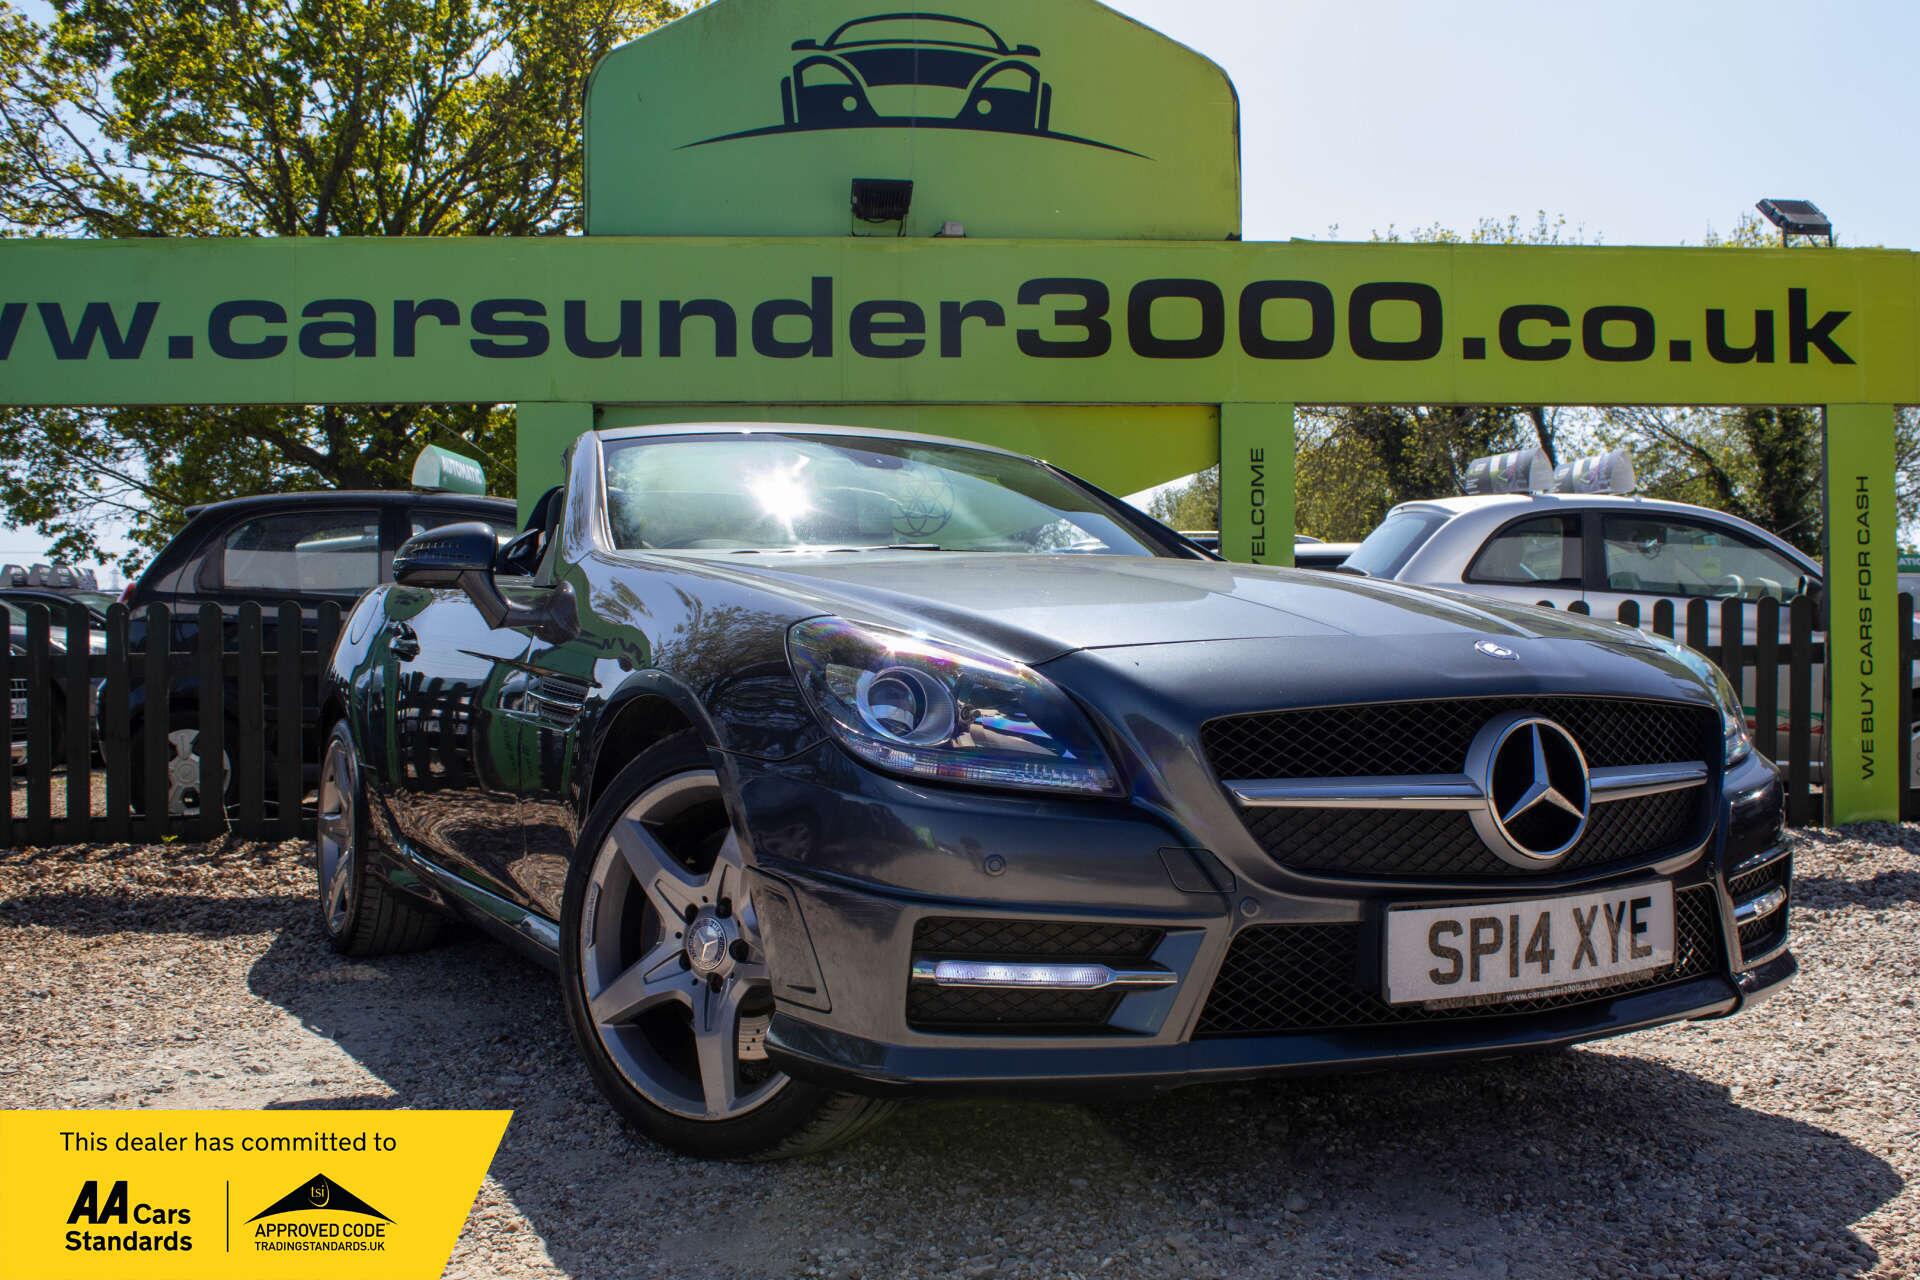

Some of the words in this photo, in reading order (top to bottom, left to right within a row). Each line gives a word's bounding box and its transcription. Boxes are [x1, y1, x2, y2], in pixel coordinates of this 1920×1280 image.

[0, 277, 1857, 364] w.carsunder3000.co.uk
[1250, 448, 1265, 564] ELCOME
[1856, 476, 1870, 546] CASH
[1858, 550, 1872, 601] FOR
[1858, 606, 1873, 676] CARS
[1860, 681, 1874, 734] BUY
[1862, 738, 1875, 780] WE
[1428, 911, 1555, 986] SP14
[1571, 896, 1653, 970] XYE
